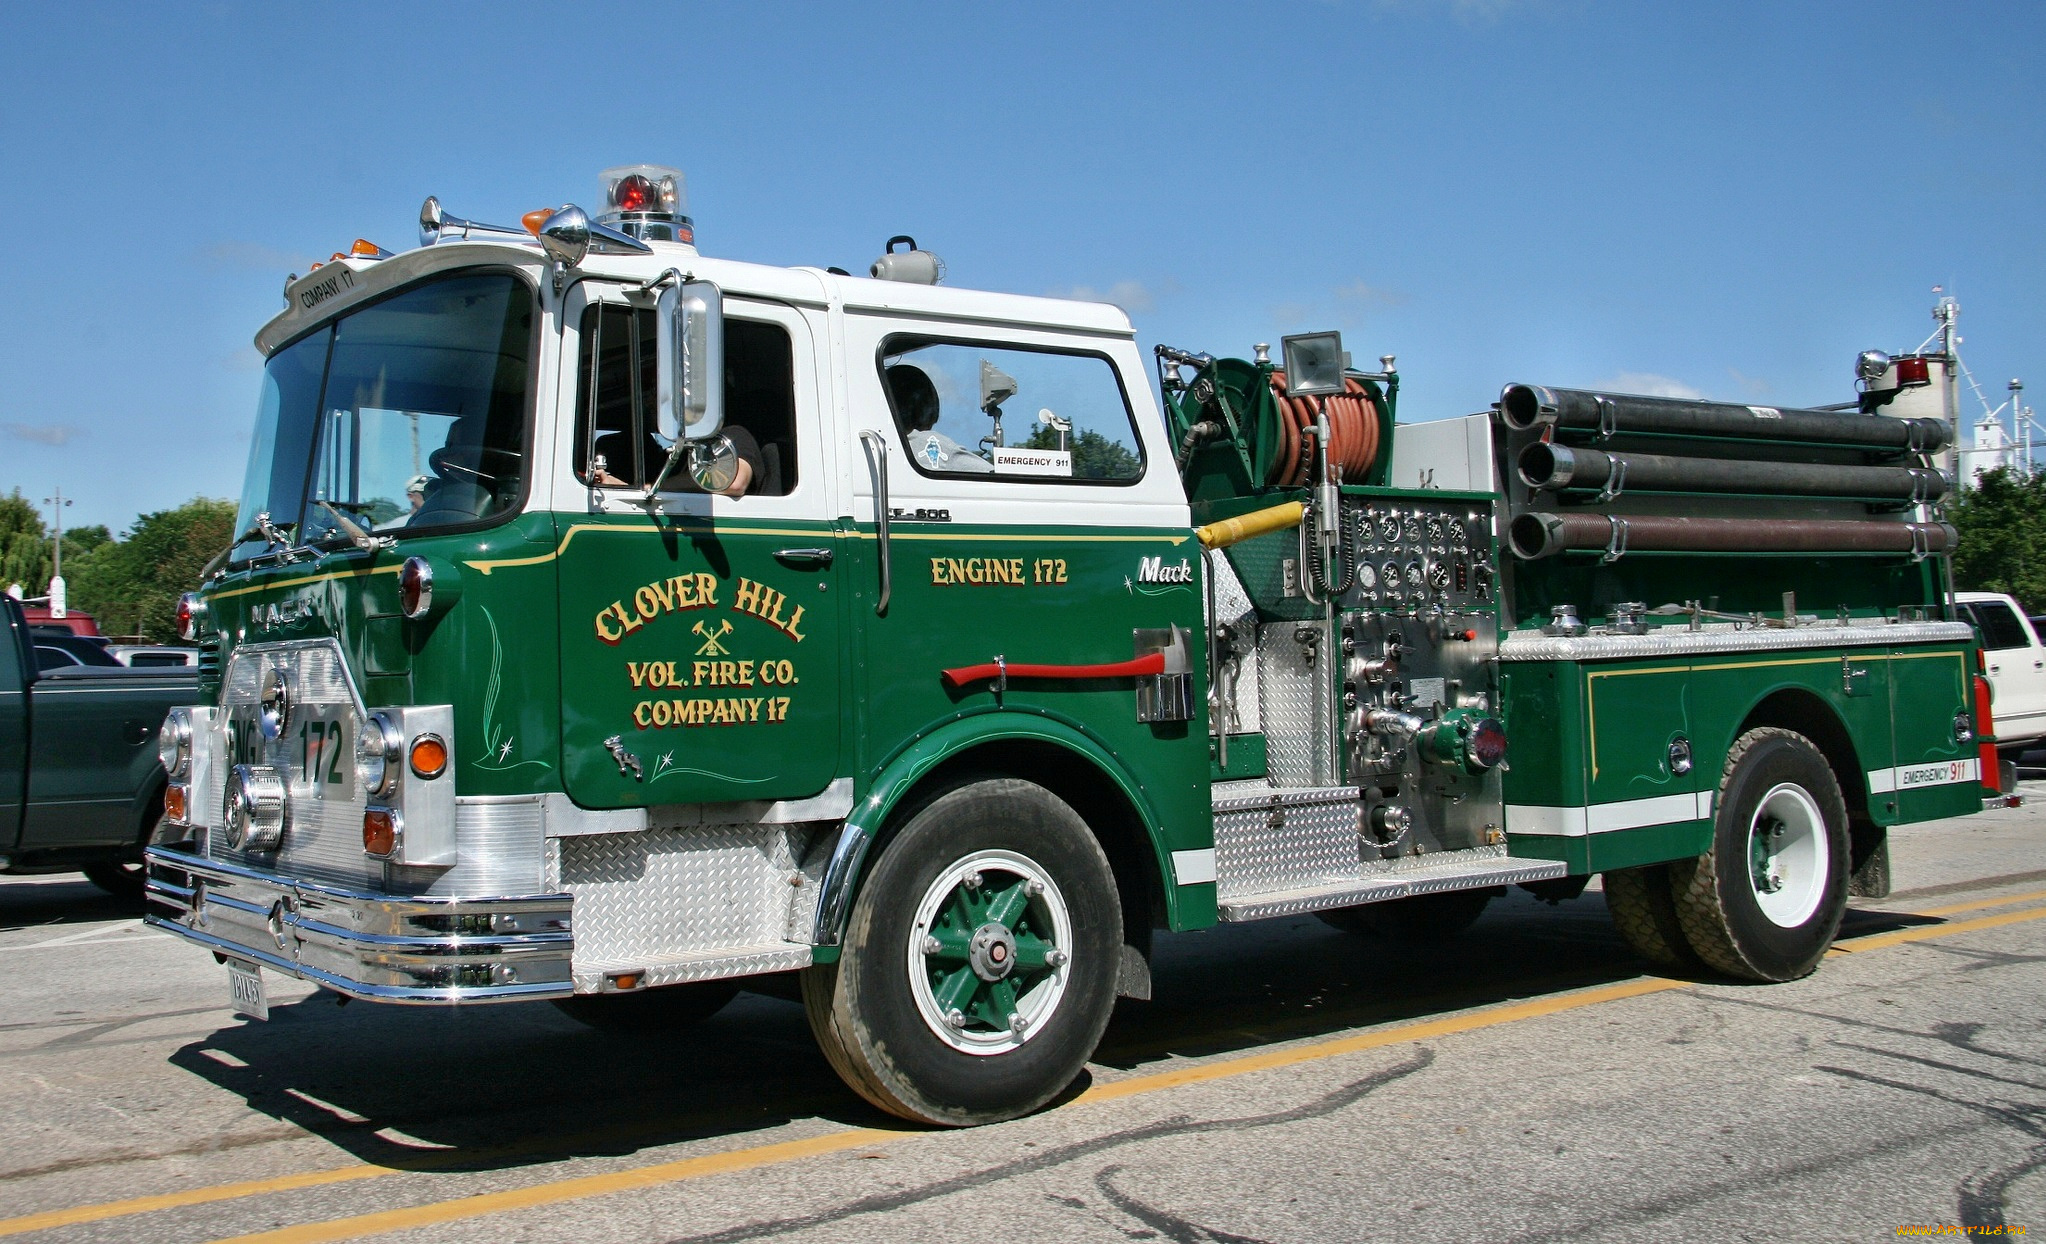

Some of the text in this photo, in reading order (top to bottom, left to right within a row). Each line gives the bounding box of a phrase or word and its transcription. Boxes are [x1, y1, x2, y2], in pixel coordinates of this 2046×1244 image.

[301, 270, 354, 308] COMPANY 17
[997, 456, 1069, 467] EMERGENCY 911
[930, 557, 1069, 586] ENGINE 172
[1138, 556, 1194, 583] Mack
[595, 572, 806, 645] CLOVER HILL
[626, 658, 800, 689] VOL. FIRE CO.
[632, 695, 791, 730] COMPANY 17
[299, 720, 344, 785] 172
[1903, 761, 1966, 785] EMERGENCY 911
